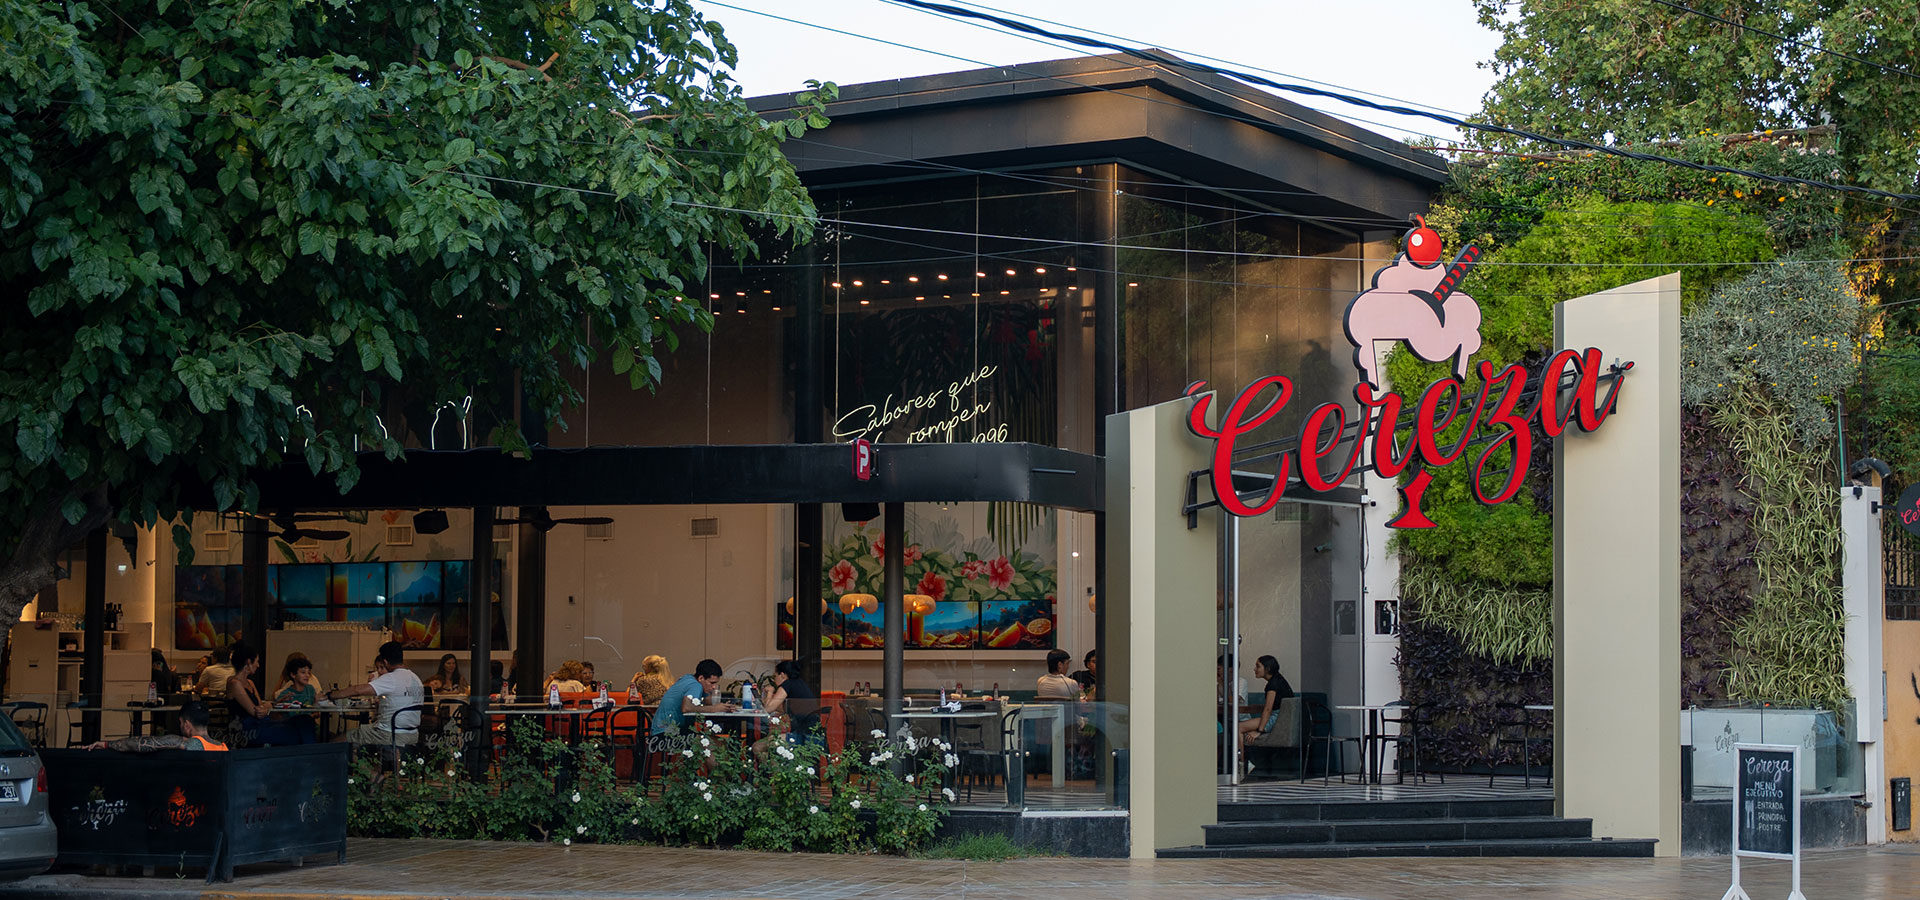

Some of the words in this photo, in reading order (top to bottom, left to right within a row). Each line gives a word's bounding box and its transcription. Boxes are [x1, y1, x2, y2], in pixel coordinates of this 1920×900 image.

[832, 389, 943, 444] Sabores
[948, 365, 998, 413] que
[906, 401, 991, 444] rompen
[1183, 346, 1635, 518] Cereza
[1745, 757, 1792, 783] Cereza
[2, 786, 16, 798] 297
[1745, 788, 1784, 798] EJECUTIVO
